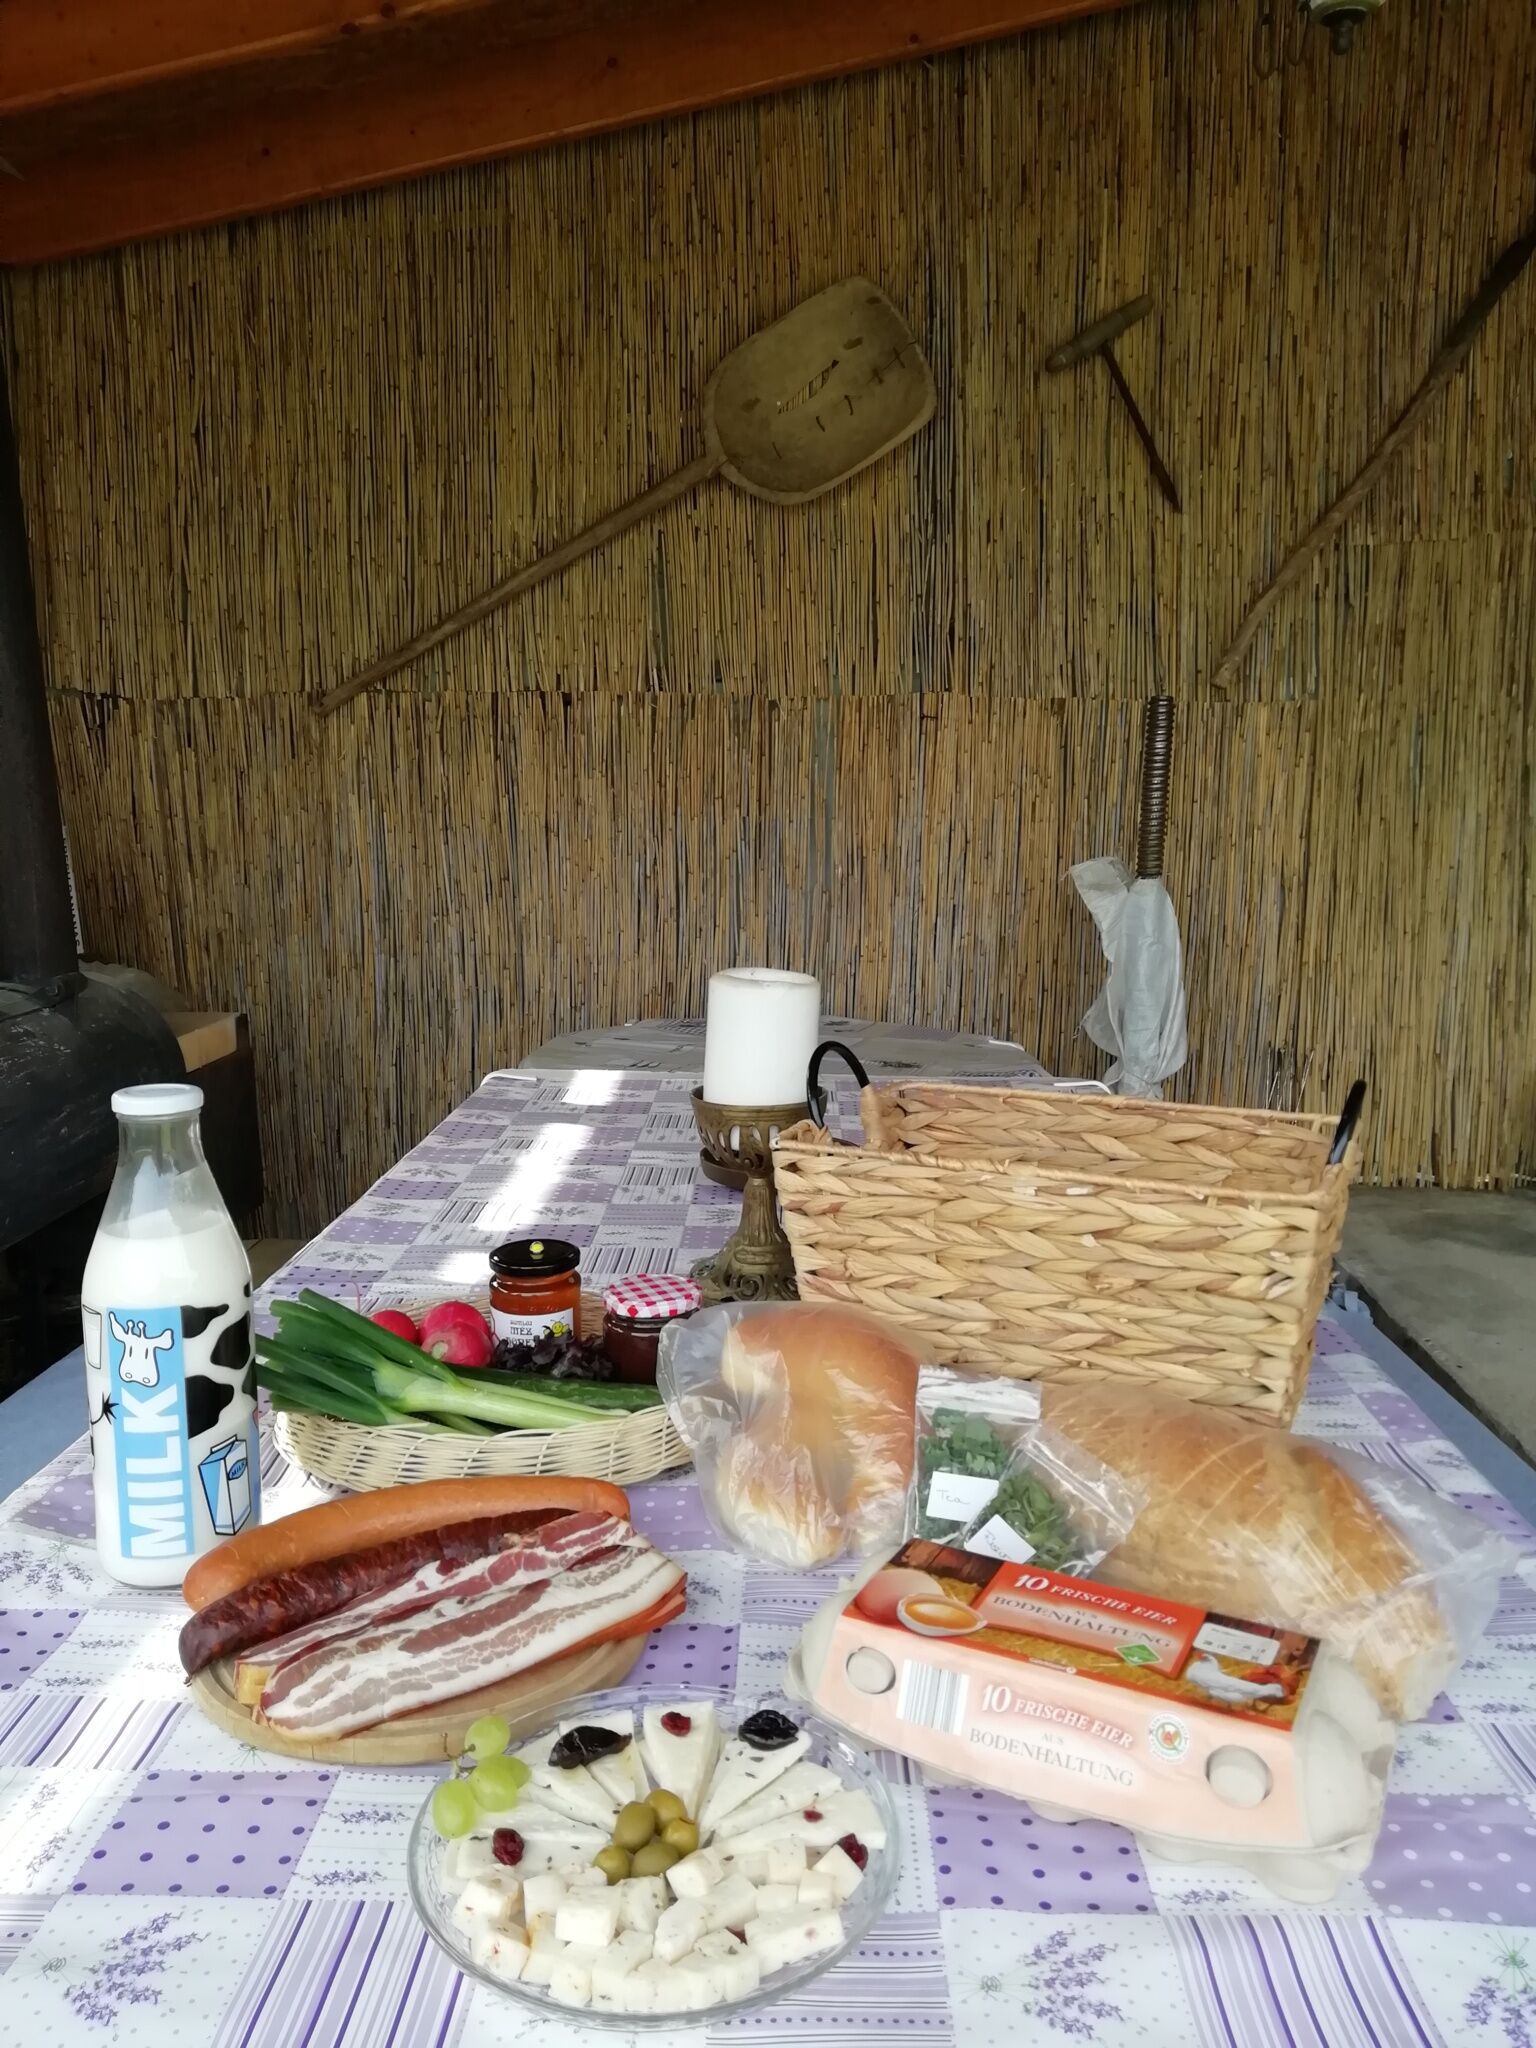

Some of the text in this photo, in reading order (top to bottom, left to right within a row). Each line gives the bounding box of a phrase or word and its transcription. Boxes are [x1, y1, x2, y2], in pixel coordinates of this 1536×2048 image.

[121, 1384, 187, 1557] MILK
[230, 1460, 245, 1477] MILK
[992, 1596, 1171, 1648] BODENHALTUNG
[1014, 1574, 1178, 1626] 10 FRISCHE EIER
[981, 1684, 1012, 1712] 10
[1014, 1699, 1091, 1731] FRISCHE
[1091, 1720, 1134, 1748] EIER
[1042, 1732, 1065, 1745] AUS
[969, 1728, 1133, 1787] BODENHALTUNG
